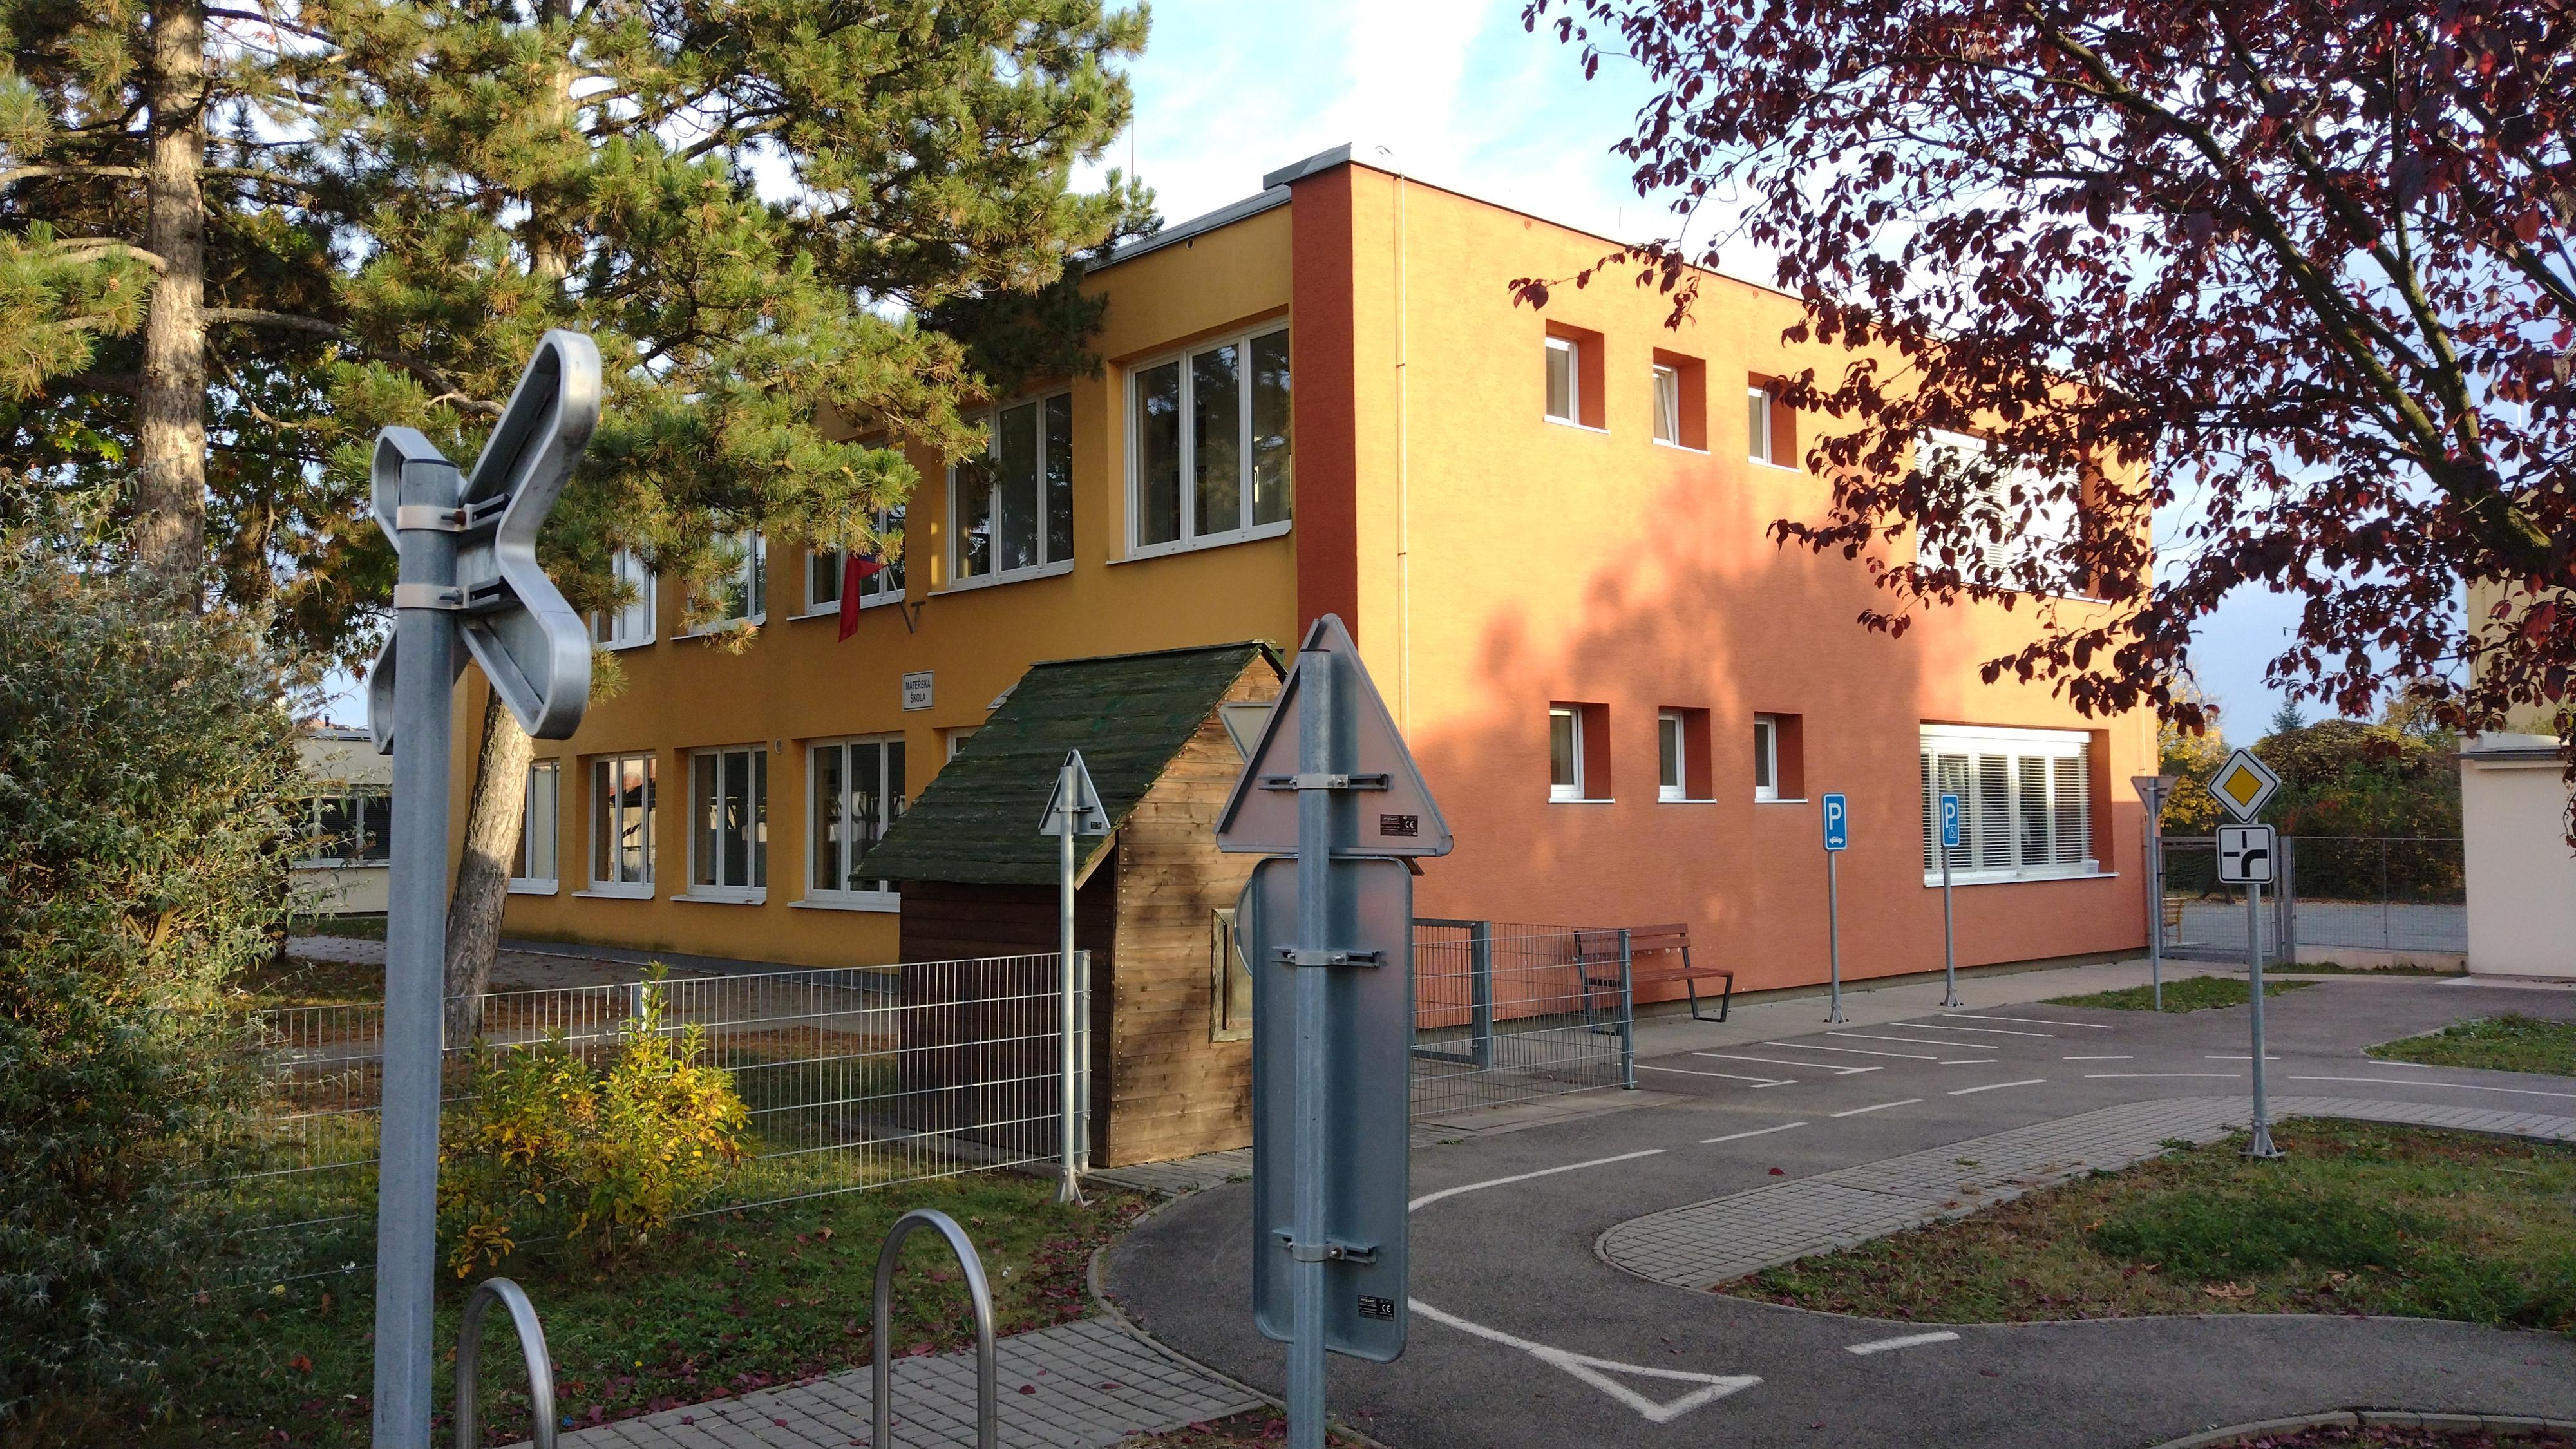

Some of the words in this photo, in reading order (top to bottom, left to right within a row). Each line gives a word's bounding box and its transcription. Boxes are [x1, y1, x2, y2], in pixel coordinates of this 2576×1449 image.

[910, 692, 926, 703] ŠKOLA
[1828, 802, 1842, 830] P
[1944, 802, 1956, 829] P
[1381, 1304, 1390, 1312] CE
